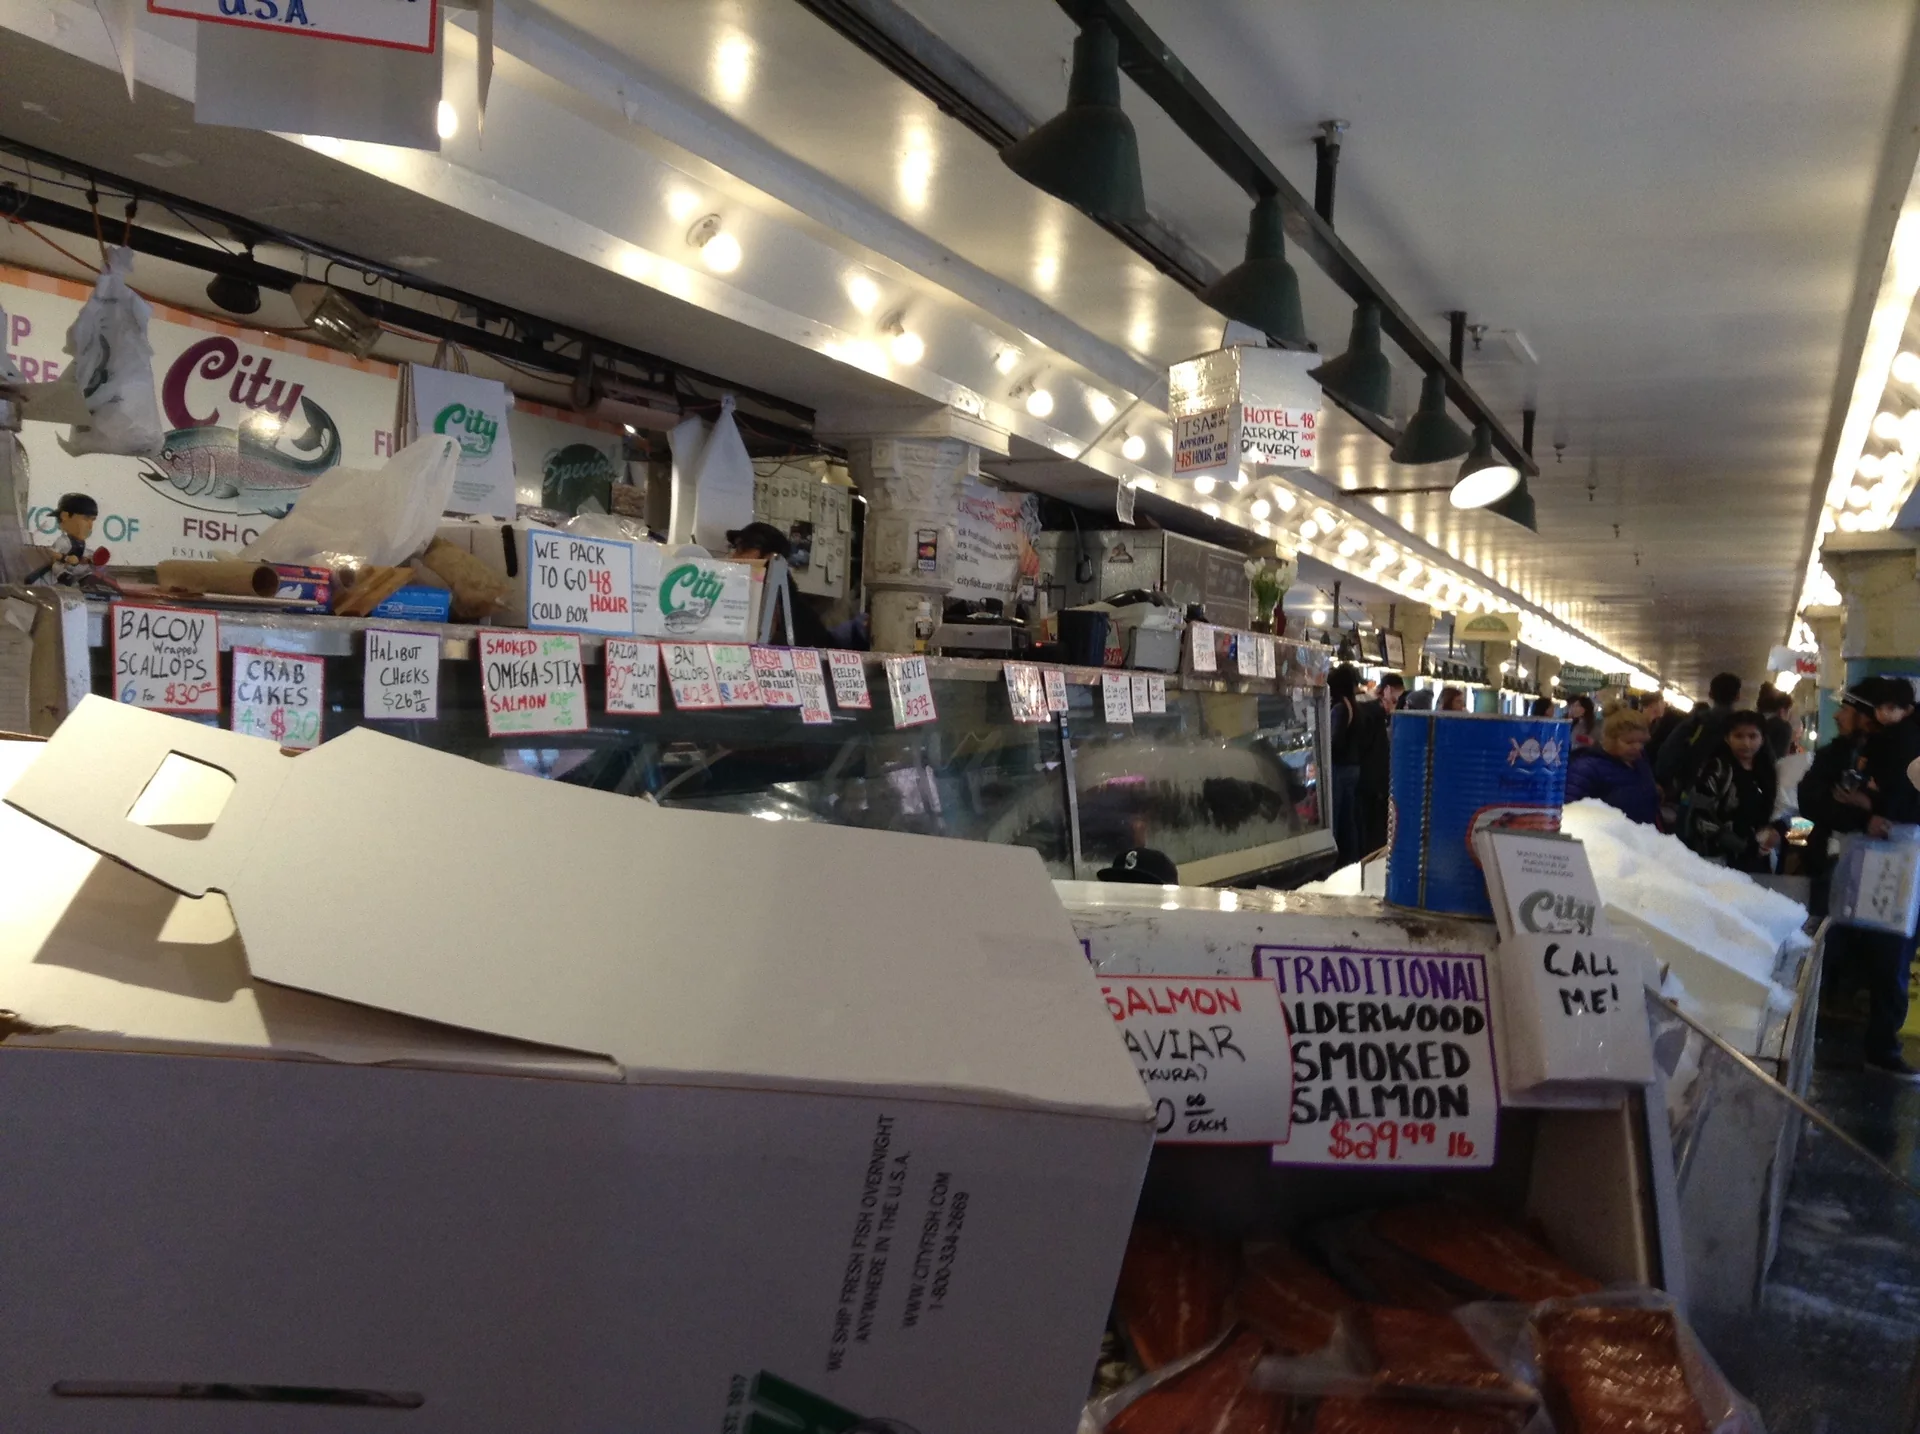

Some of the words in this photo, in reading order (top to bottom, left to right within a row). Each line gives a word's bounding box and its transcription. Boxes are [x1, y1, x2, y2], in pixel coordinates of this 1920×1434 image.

[162, 335, 304, 431] City
[433, 402, 499, 447] City
[1183, 416, 1211, 437] TSA
[1243, 406, 1298, 428] HOTEL
[1300, 412, 1315, 429] 48
[1179, 433, 1215, 450] APPROVED
[1241, 425, 1298, 444] AIRPORT
[1176, 450, 1192, 468] 48
[1192, 447, 1212, 465] HOUR
[1241, 439, 1299, 460] DELIVERY
[103, 515, 140, 542] OF
[183, 517, 237, 542] FISH
[534, 539, 559, 560] WE
[570, 542, 605, 566] PACK
[538, 564, 558, 588] TO
[563, 568, 587, 592] GO
[588, 569, 612, 595] 48
[659, 563, 725, 616] City
[532, 601, 562, 620] COLD
[566, 604, 589, 623] BOX
[590, 593, 628, 614] HOUR
[118, 610, 205, 644] BACON
[370, 635, 422, 662] HALIBUT
[487, 638, 537, 658] SMOKED
[608, 642, 638, 660] RAZOR
[673, 646, 695, 668] BAY
[832, 653, 859, 665] WILD
[117, 651, 208, 681] SCALLOPS
[246, 660, 306, 685] CRAB
[380, 667, 430, 688] CHEEKS
[488, 659, 583, 692] OMEGA-STIX
[631, 662, 657, 679] CLAM
[669, 666, 710, 682] SCALLOPS
[716, 666, 752, 681] Prawns
[757, 669, 777, 678] LOCAL
[778, 669, 795, 678] LING
[121, 680, 137, 704] 6
[238, 682, 309, 707] CAKES
[631, 682, 657, 699] MEAT
[773, 680, 795, 689] FILLET
[490, 693, 547, 714] SALMON
[270, 707, 319, 742] $20
[1518, 888, 1596, 934] City
[1544, 942, 1619, 977] CALL
[1269, 955, 1488, 1002] TRADITIONAL
[1101, 985, 1243, 1021] SALMON
[1559, 983, 1619, 1016] ME!
[1125, 1025, 1246, 1063] AVIAR
[1292, 1040, 1472, 1083] SMOKED
[1290, 1083, 1471, 1125] SALMON
[1187, 1116, 1228, 1134] EACH
[861, 1113, 896, 1208] OVERNIGHT
[879, 1200, 900, 1232] THE
[851, 1211, 875, 1249] FISH
[874, 1236, 892, 1254] IN
[902, 1171, 953, 1329] WWW.CITYFISH.COM
[840, 1251, 865, 1305] FRESH
[855, 1255, 887, 1343] ANYWHERE
[833, 1307, 853, 1345] SHIP
[827, 1347, 846, 1373] WE
